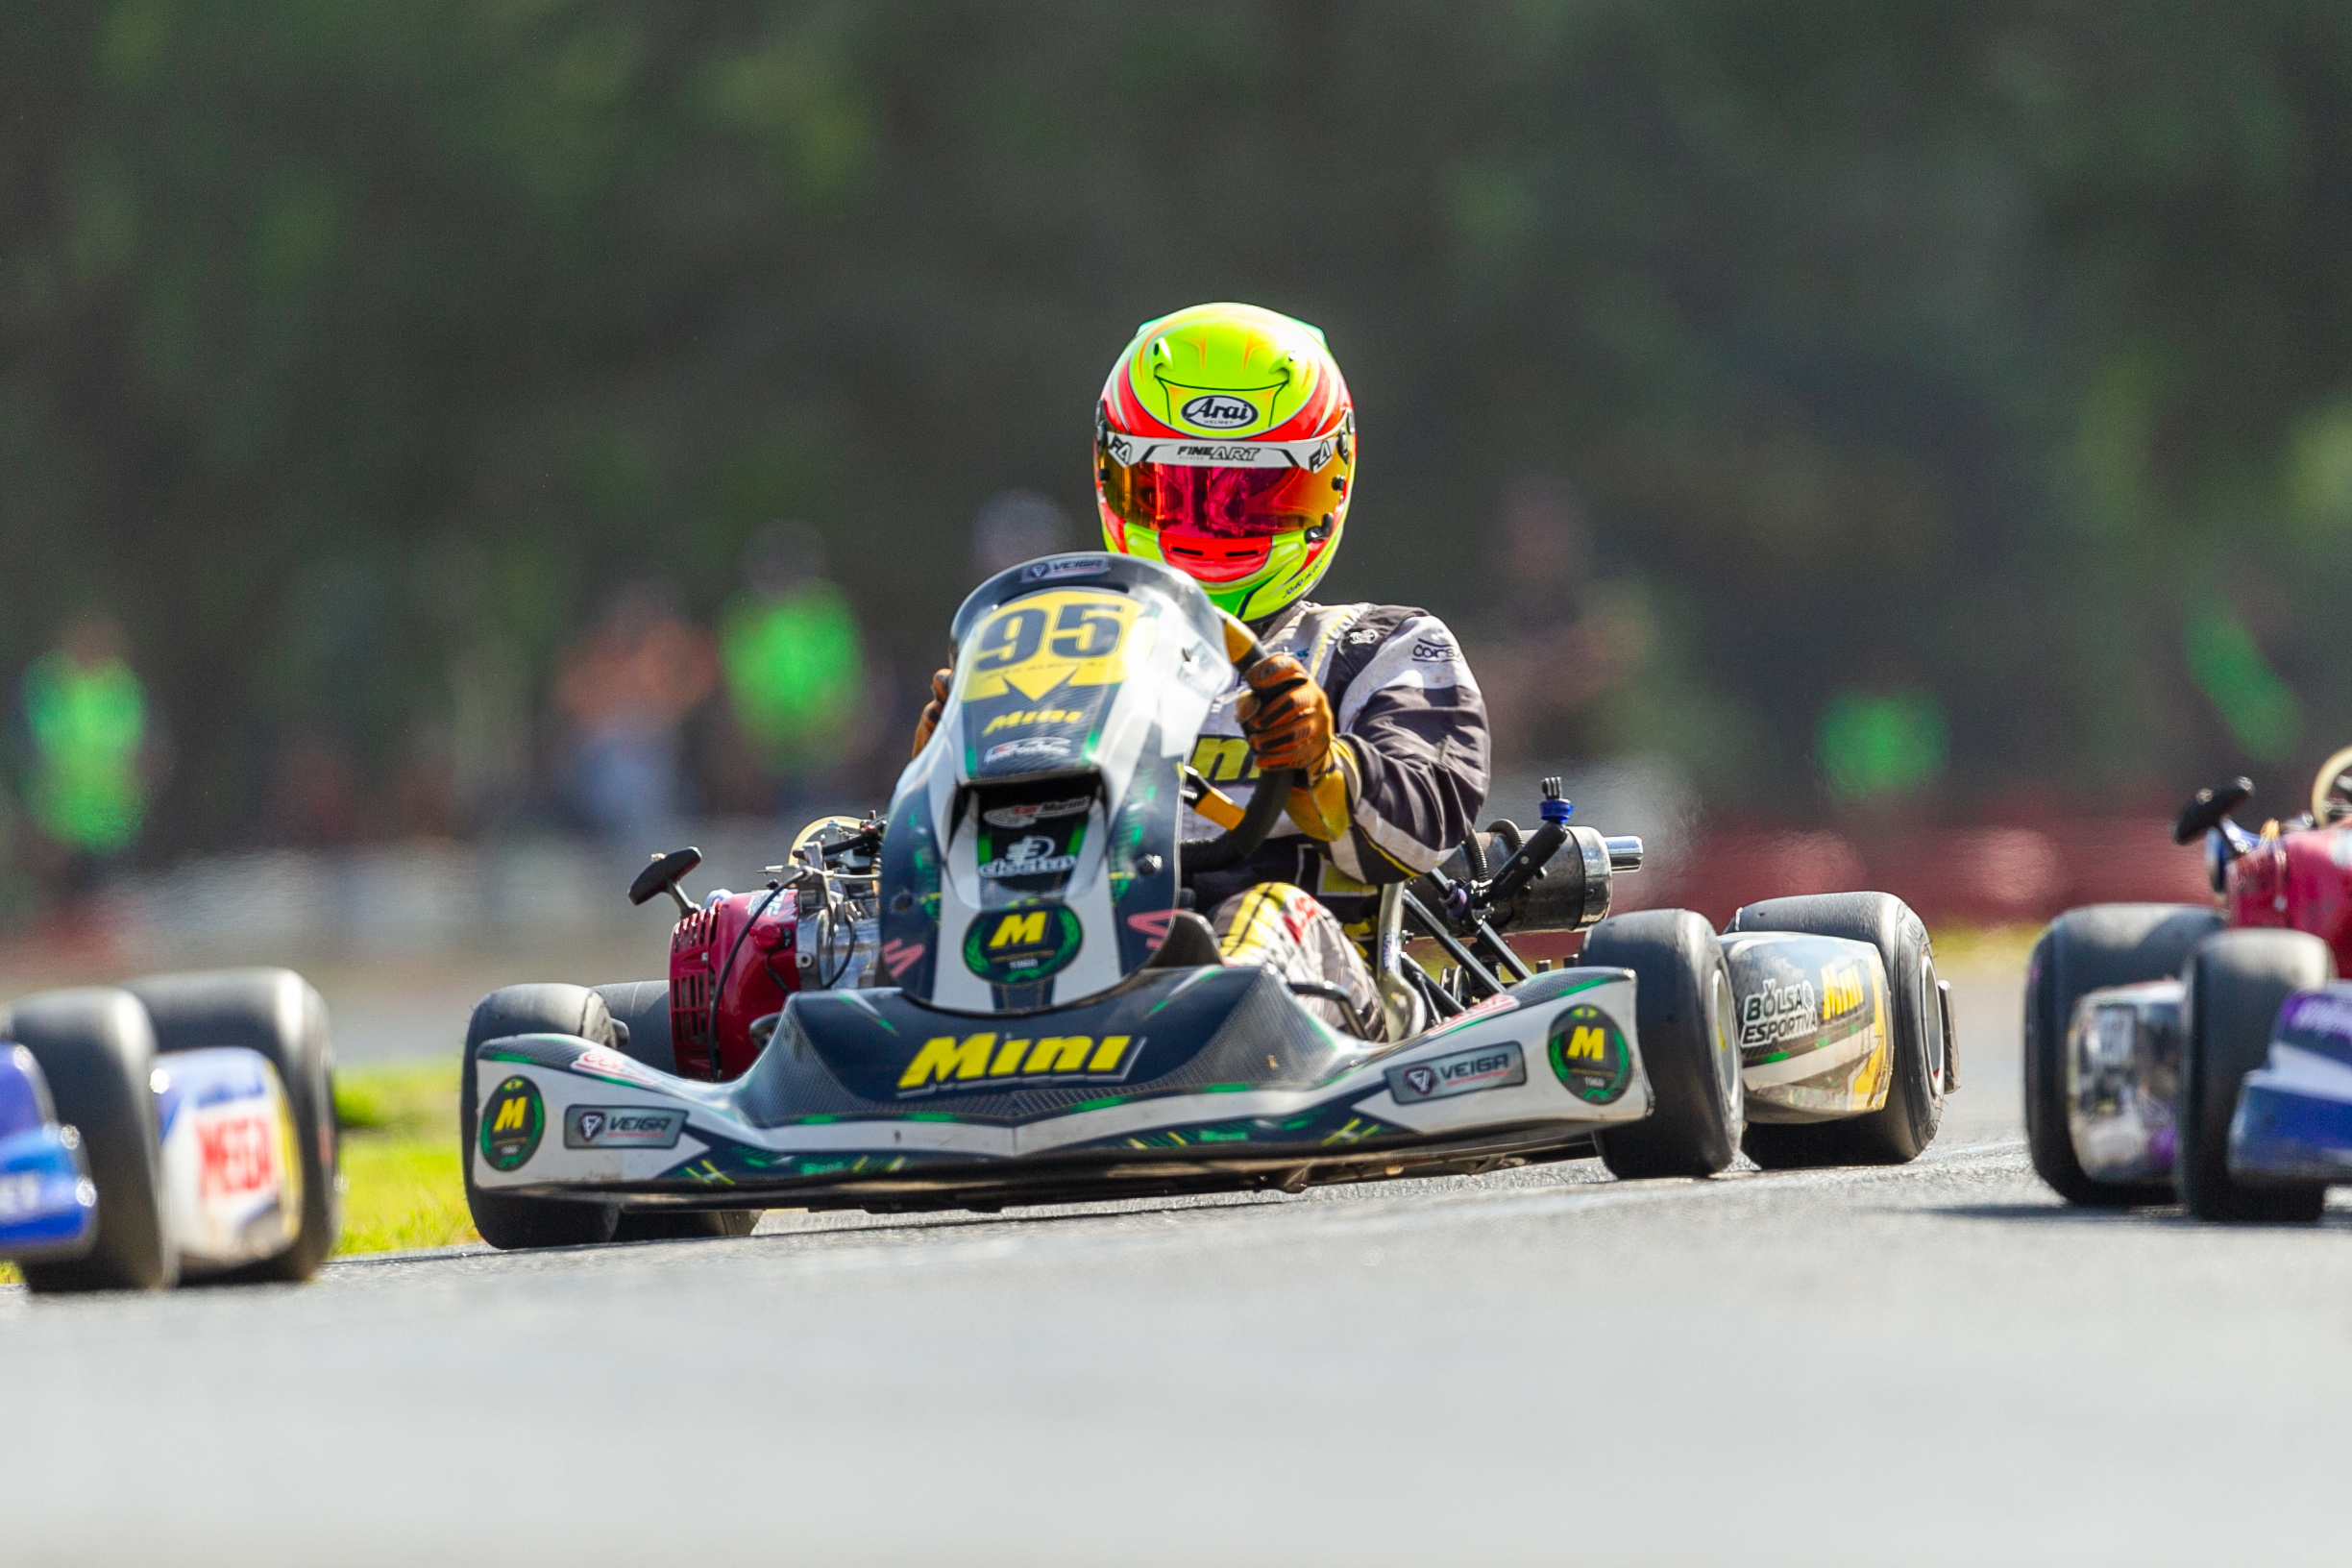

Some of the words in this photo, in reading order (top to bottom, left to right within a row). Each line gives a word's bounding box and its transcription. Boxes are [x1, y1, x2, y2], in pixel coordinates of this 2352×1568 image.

[1185, 398, 1249, 420] Arai
[1054, 559, 1103, 570] VEIGA
[976, 603, 1124, 671] 95
[989, 911, 1046, 948] M
[1567, 1025, 1605, 1061] M
[1741, 1012, 1816, 1045] ESPORTIVA
[1440, 1053, 1508, 1079] VEIGA
[493, 1096, 527, 1133] M
[609, 1116, 672, 1130] VEIGA
